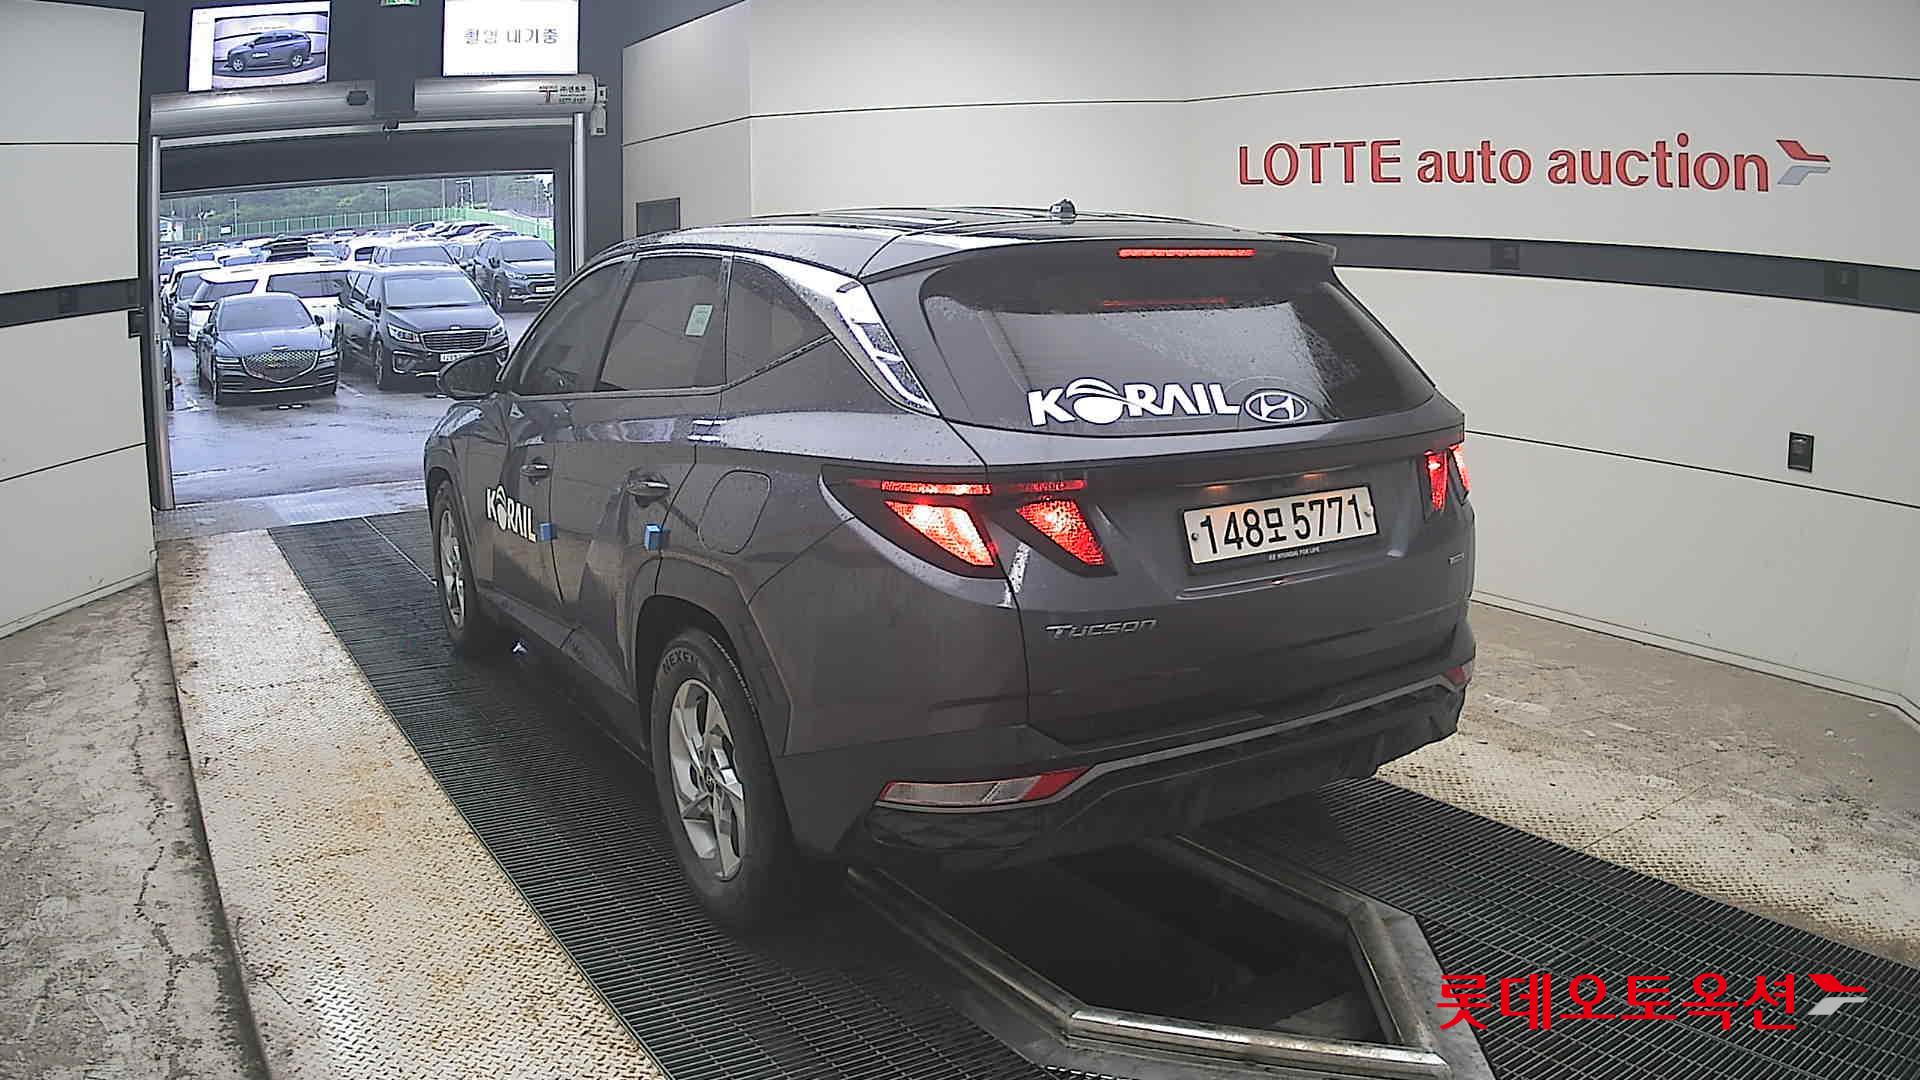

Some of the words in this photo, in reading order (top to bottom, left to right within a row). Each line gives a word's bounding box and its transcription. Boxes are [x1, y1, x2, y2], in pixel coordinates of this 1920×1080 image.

[1238, 139, 1403, 186] LOTTE
[1417, 139, 1533, 185] auto
[1547, 132, 1770, 193] auction
[1027, 377, 1242, 427] KORAIL
[486, 485, 537, 543] KORAIL
[1200, 492, 1364, 555] 148모5771
